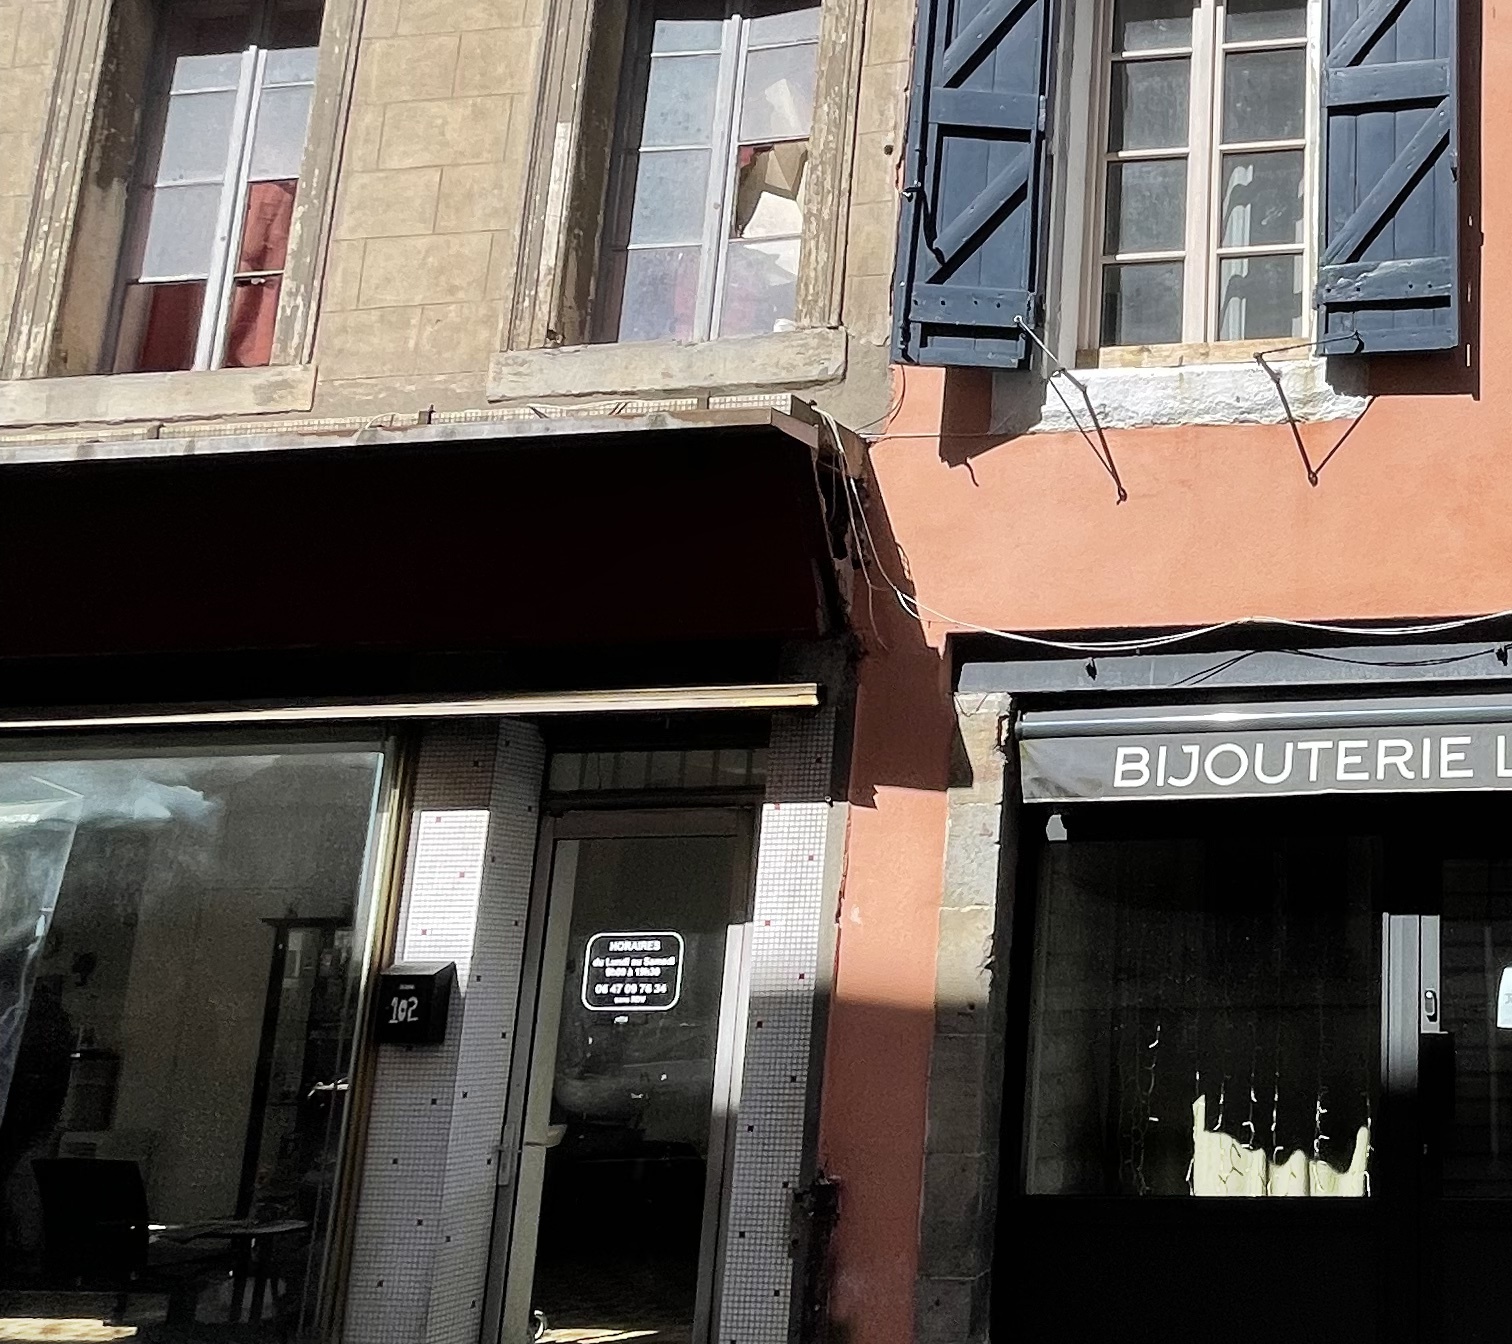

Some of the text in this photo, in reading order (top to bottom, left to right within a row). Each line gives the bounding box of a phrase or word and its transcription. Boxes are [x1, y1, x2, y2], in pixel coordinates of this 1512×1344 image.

[1113, 736, 1474, 788] BIJOUTERIE
[608, 940, 661, 952] HORAIRES
[609, 984, 624, 994] 47
[653, 984, 667, 994] 34
[388, 996, 419, 1024] 102
